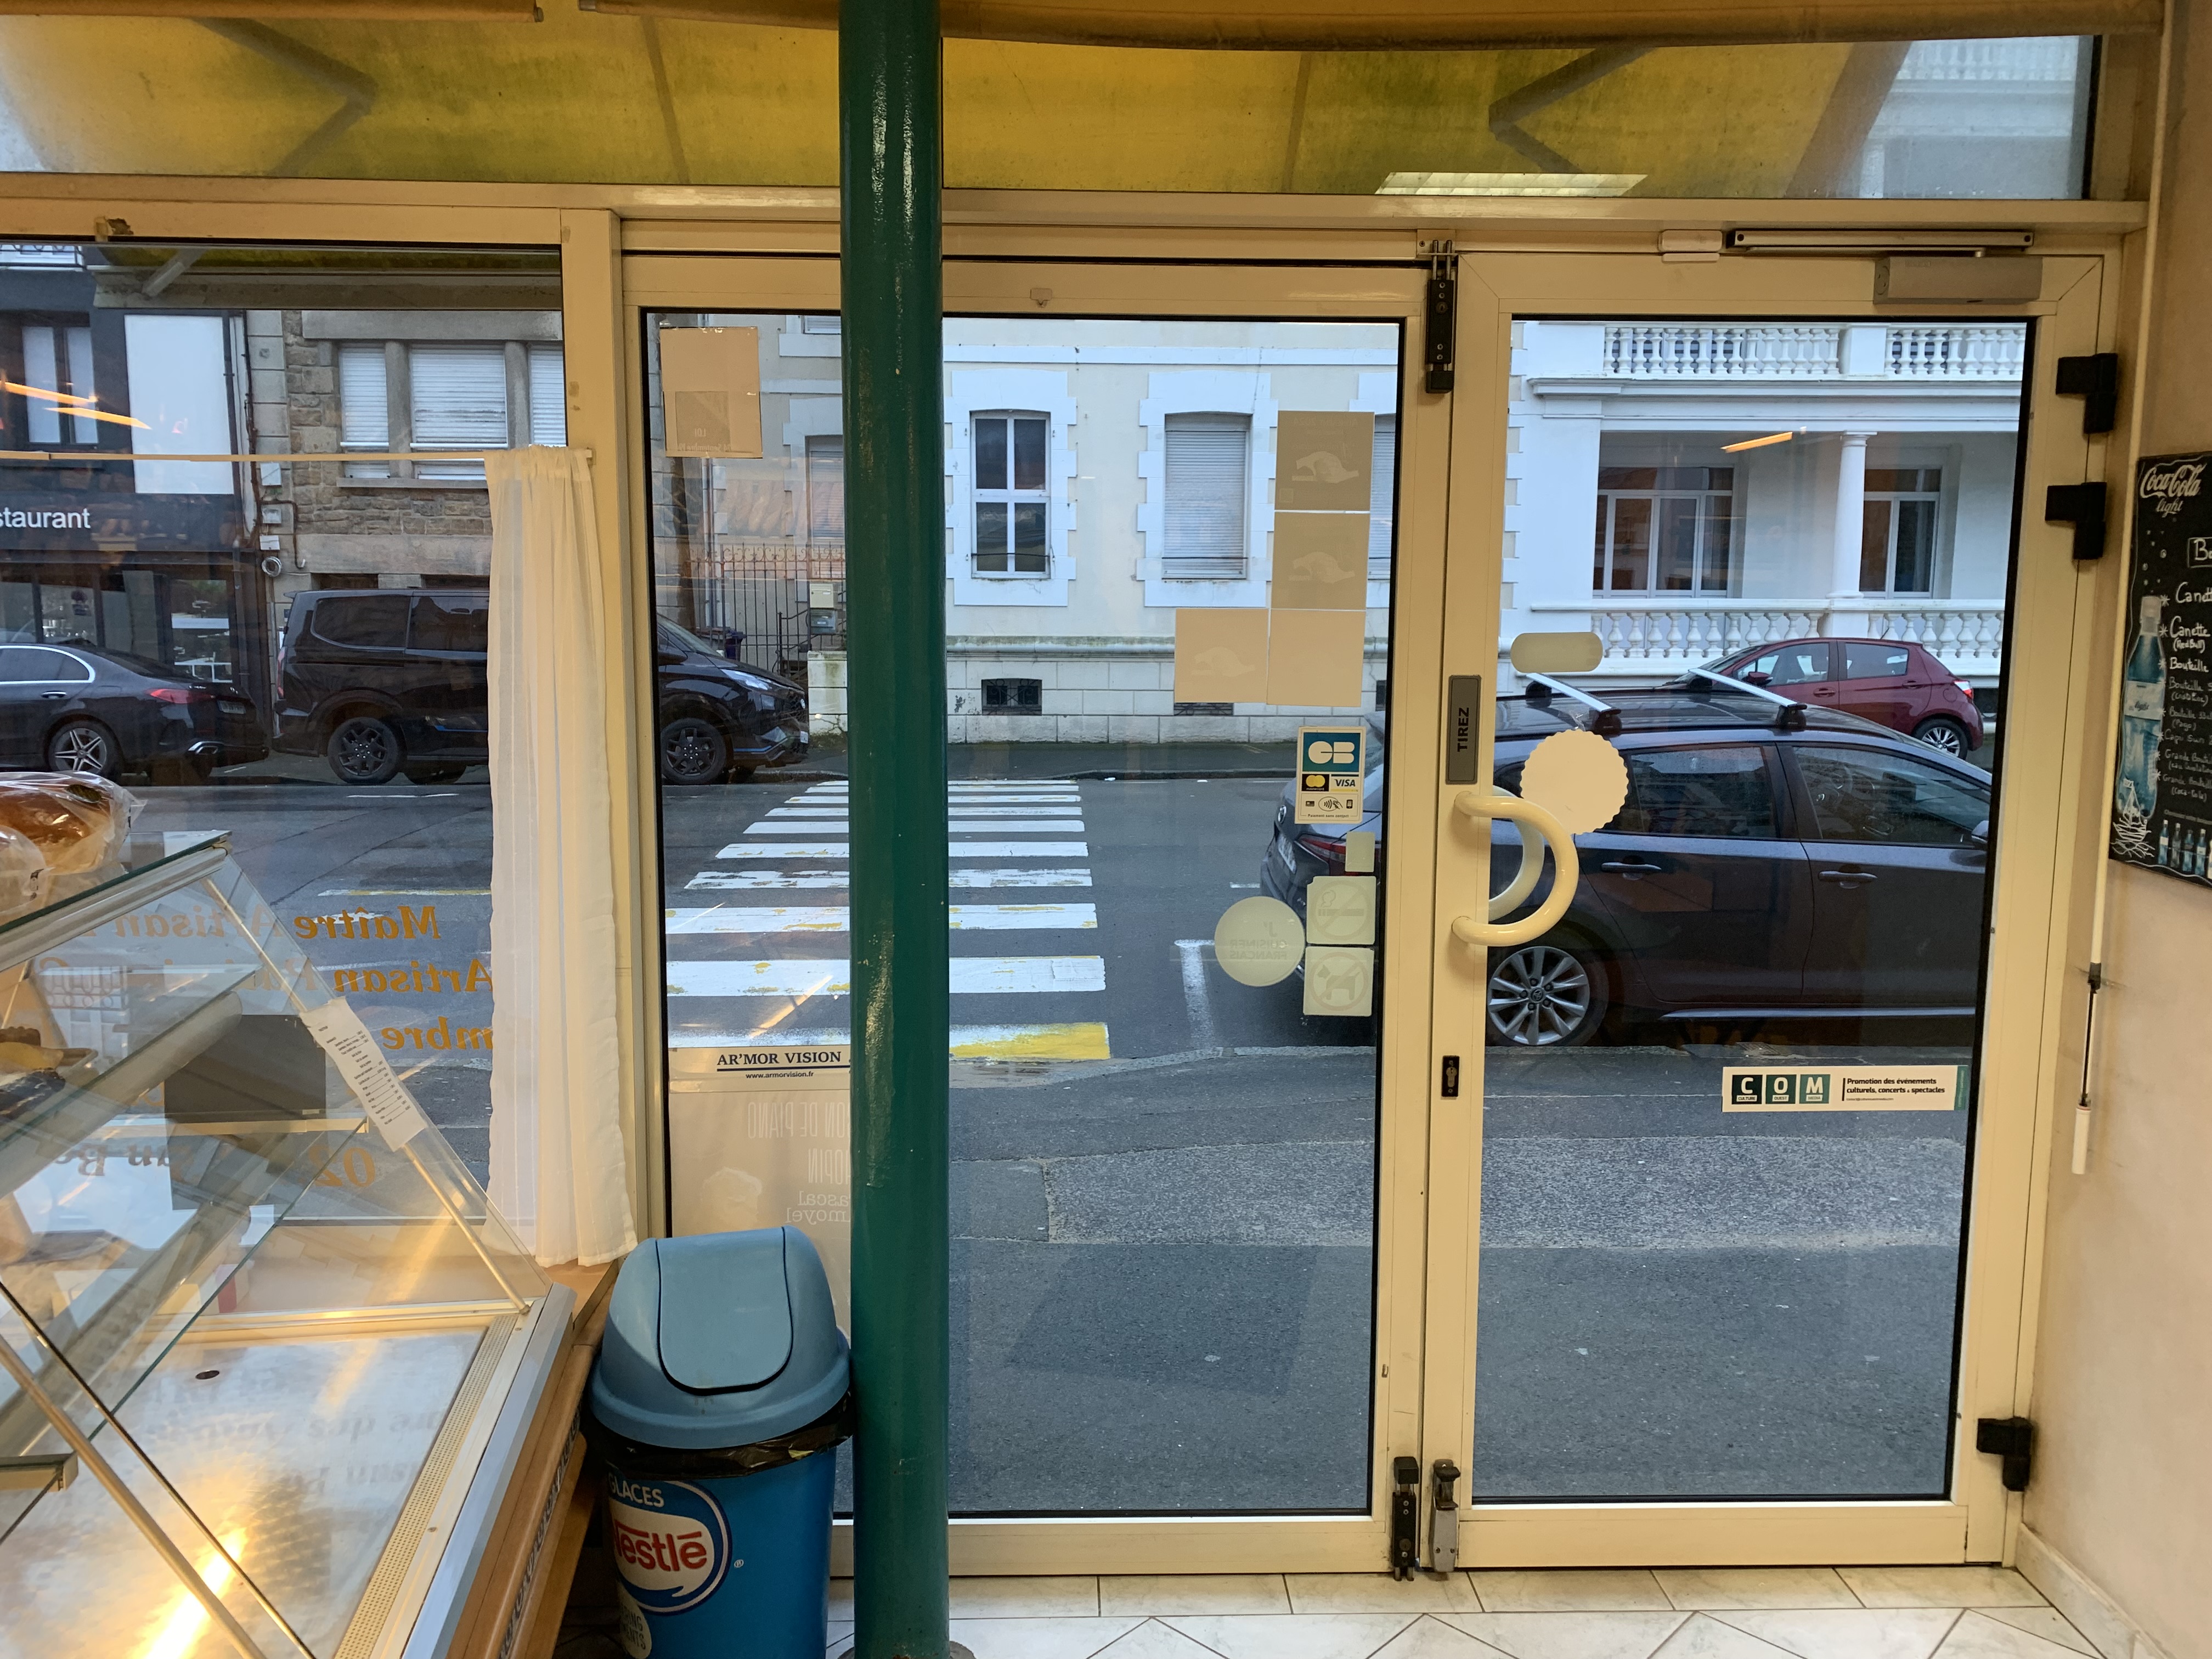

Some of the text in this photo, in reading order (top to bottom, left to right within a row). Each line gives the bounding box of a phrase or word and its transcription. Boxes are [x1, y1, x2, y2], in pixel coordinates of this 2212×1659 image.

[2156, 498, 2183, 517] light
[2170, 616, 2211, 638] Canette
[2169, 657, 2209, 673] Bouteille
[1457, 707, 1469, 752] TIREZ
[785, 1051, 842, 1063] VISION
[608, 1472, 665, 1508] GLACES
